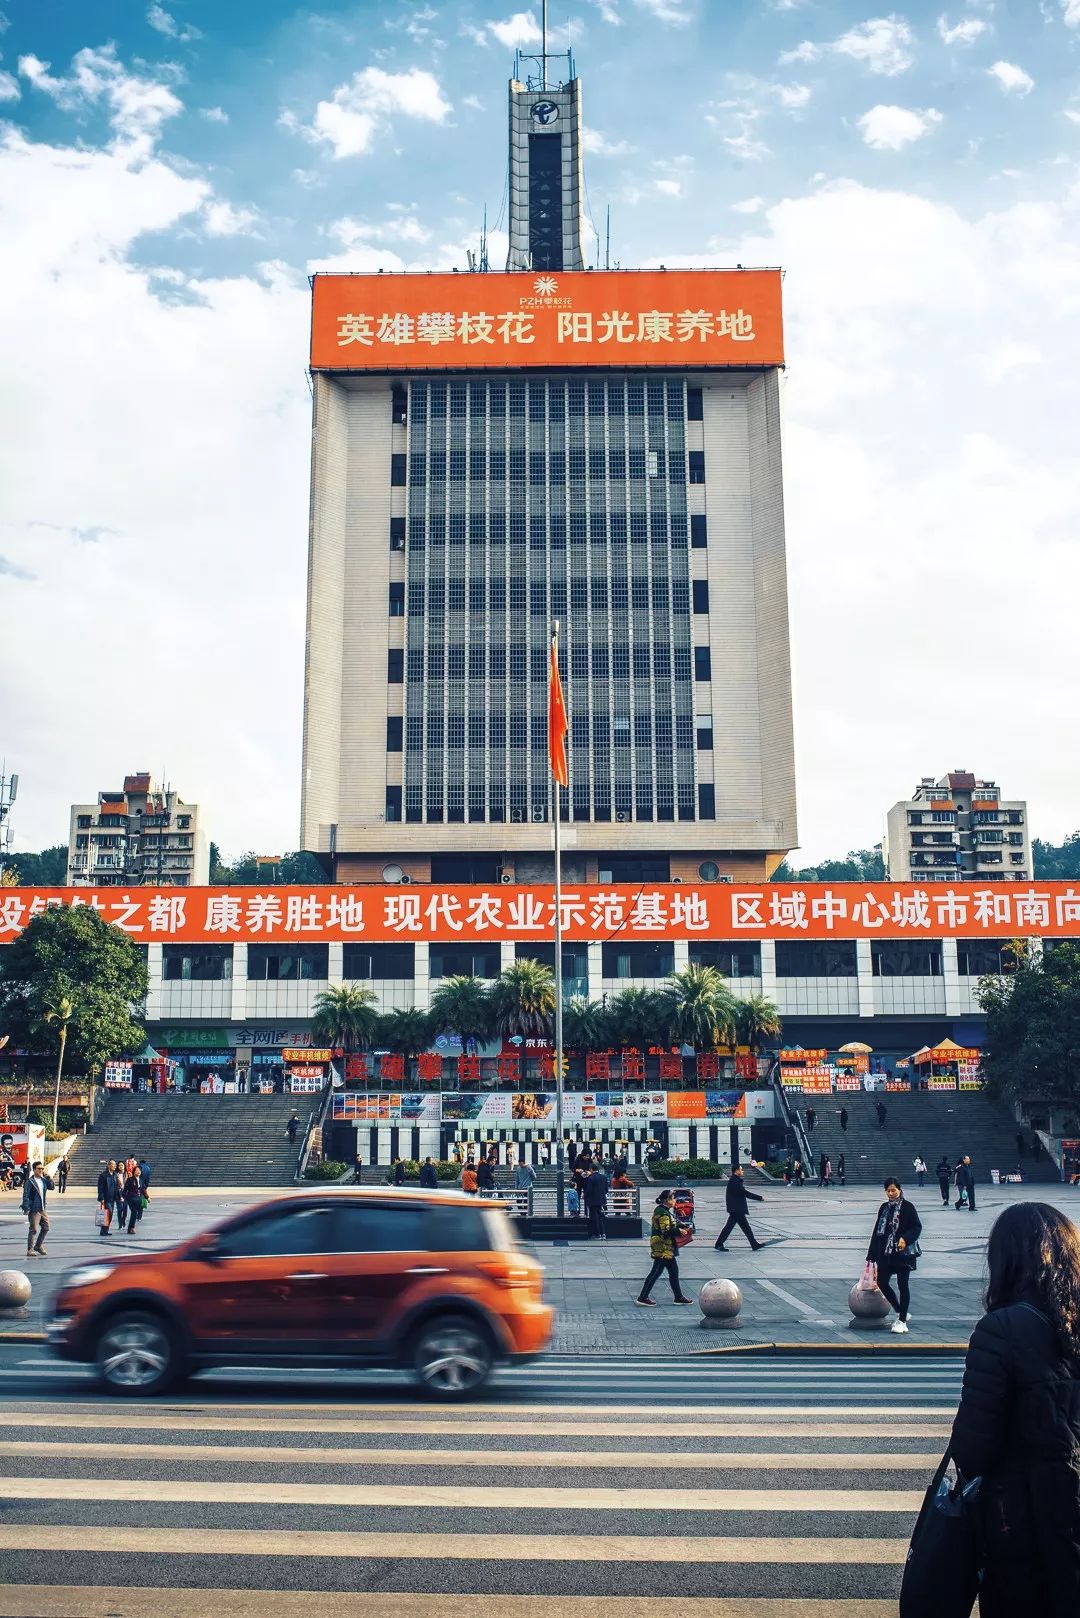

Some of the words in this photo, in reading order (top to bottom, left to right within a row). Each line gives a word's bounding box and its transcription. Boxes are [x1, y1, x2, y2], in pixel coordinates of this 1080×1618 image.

[336, 313, 536, 346] 英雄攀枝花
[557, 309, 756, 344] 阳光康养地
[0, 895, 187, 934] 设之都
[203, 894, 366, 934] 康养胜地
[383, 892, 710, 932] 现代农业示范基地
[731, 889, 1080, 930] 区域中心城市和南向
[284, 1050, 329, 1060] 专业手机维修
[932, 1049, 977, 1058] 专业手机维修
